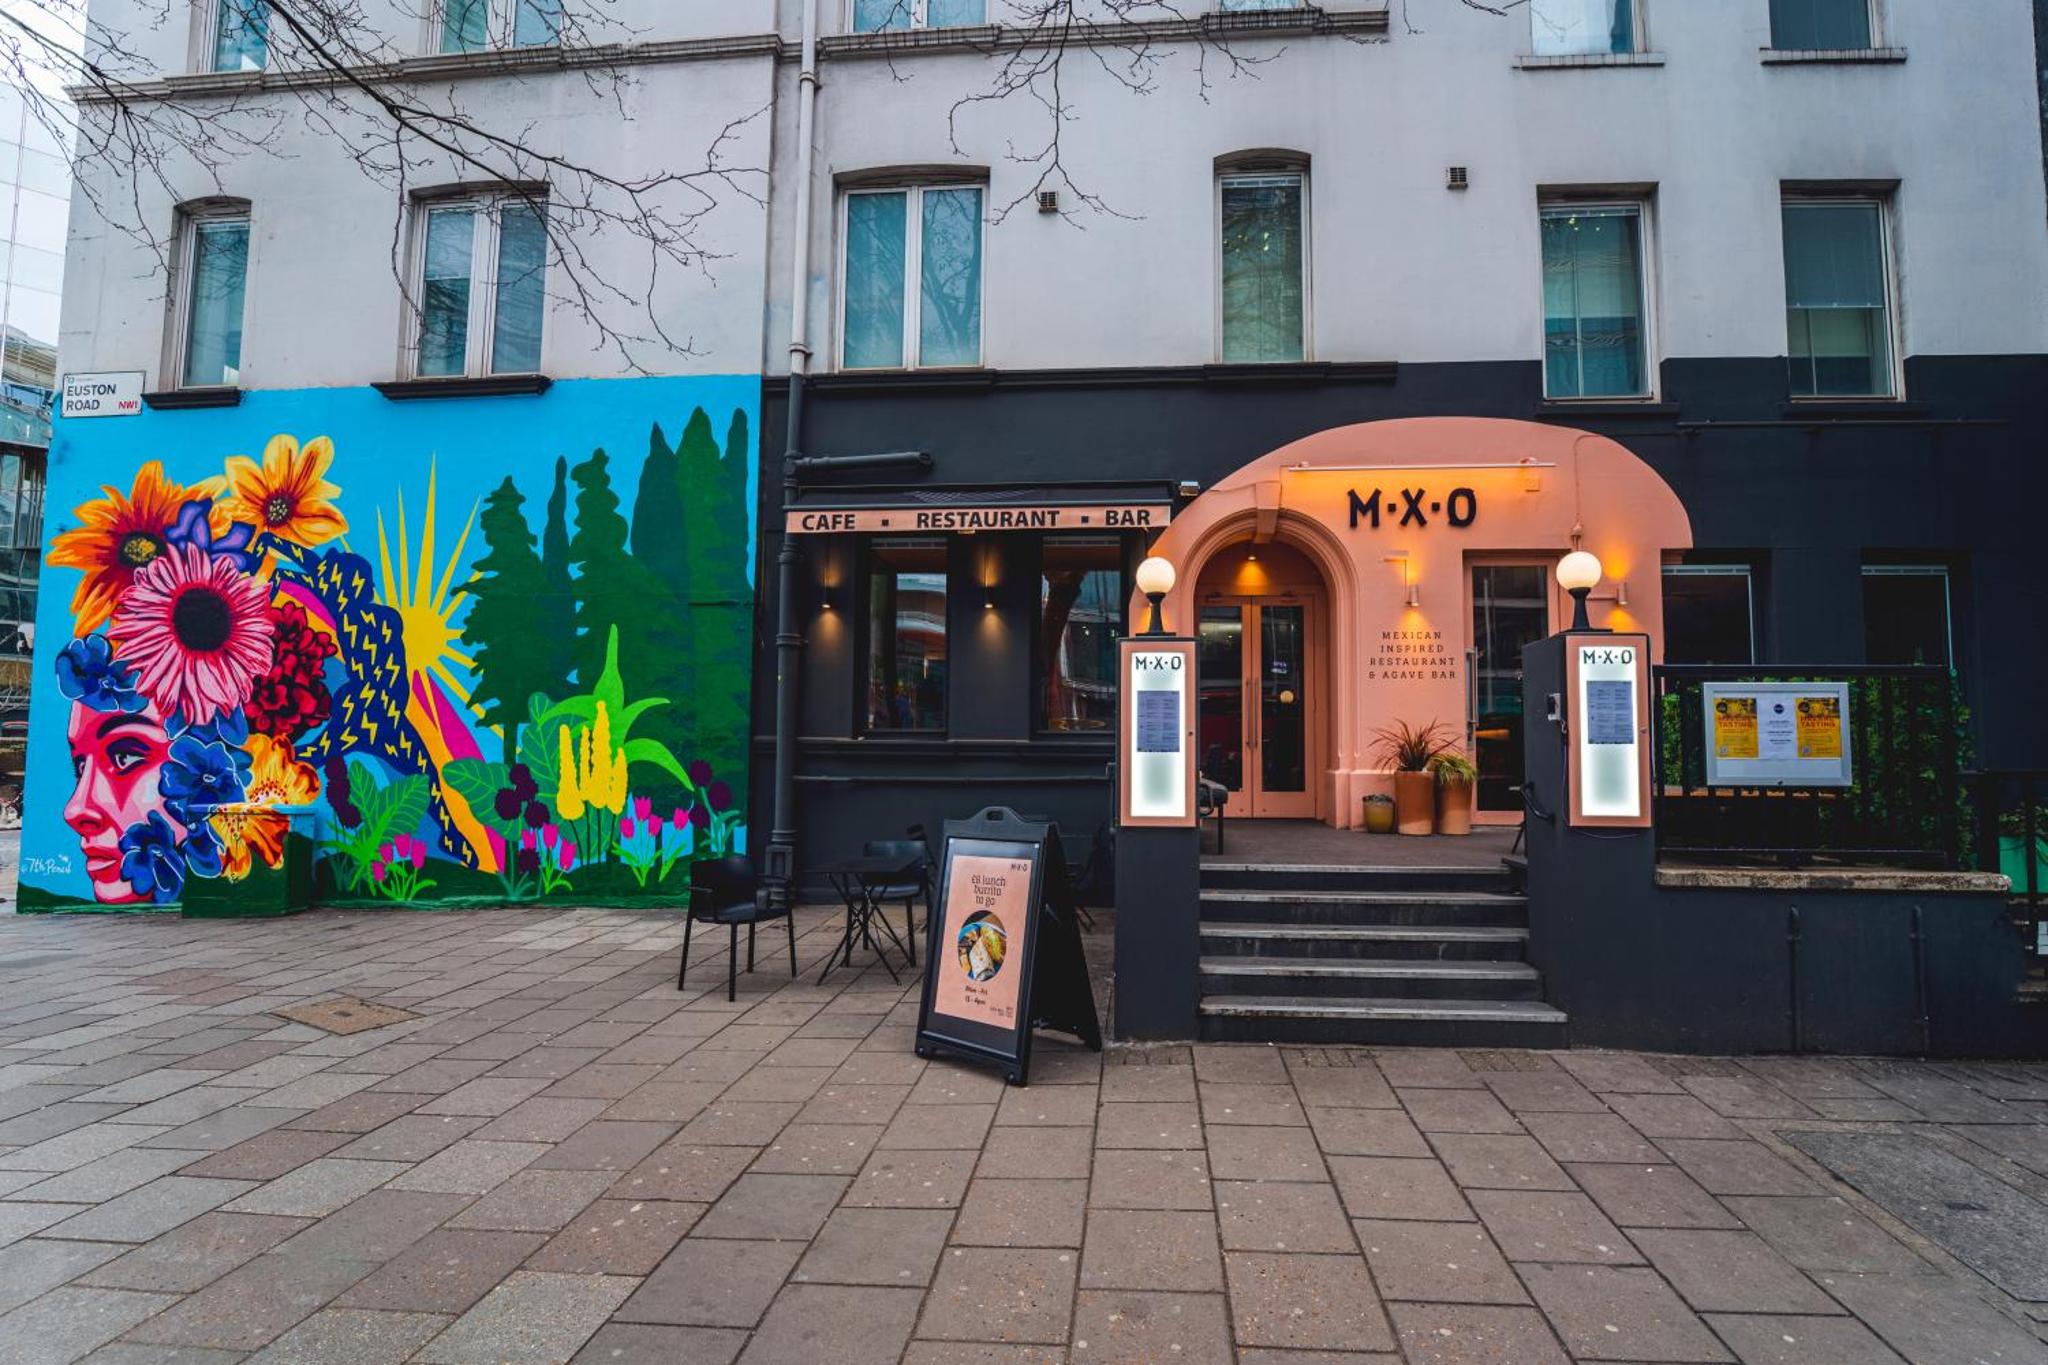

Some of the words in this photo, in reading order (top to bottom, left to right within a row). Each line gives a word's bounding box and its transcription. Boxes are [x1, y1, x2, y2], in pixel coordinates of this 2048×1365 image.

[67, 384, 117, 397] EUSTON
[66, 400, 100, 411] ROAD
[118, 401, 138, 409] NW1
[802, 514, 856, 531] CAFE
[917, 510, 1060, 529] RESTAURANT
[1105, 509, 1151, 526] BAR
[1382, 631, 1441, 640] MEXICAN
[1380, 644, 1444, 653] INSPIRED
[1369, 657, 1455, 666] RESTAURANT
[1368, 671, 1376, 679] &
[1382, 671, 1424, 679] AGAVE
[1431, 671, 1456, 679] BAR
[1801, 720, 1836, 728] TASTING
[982, 875, 1006, 887] lunch
[974, 885, 1002, 896] burrito
[976, 895, 984, 905] to
[985, 896, 996, 908] go
